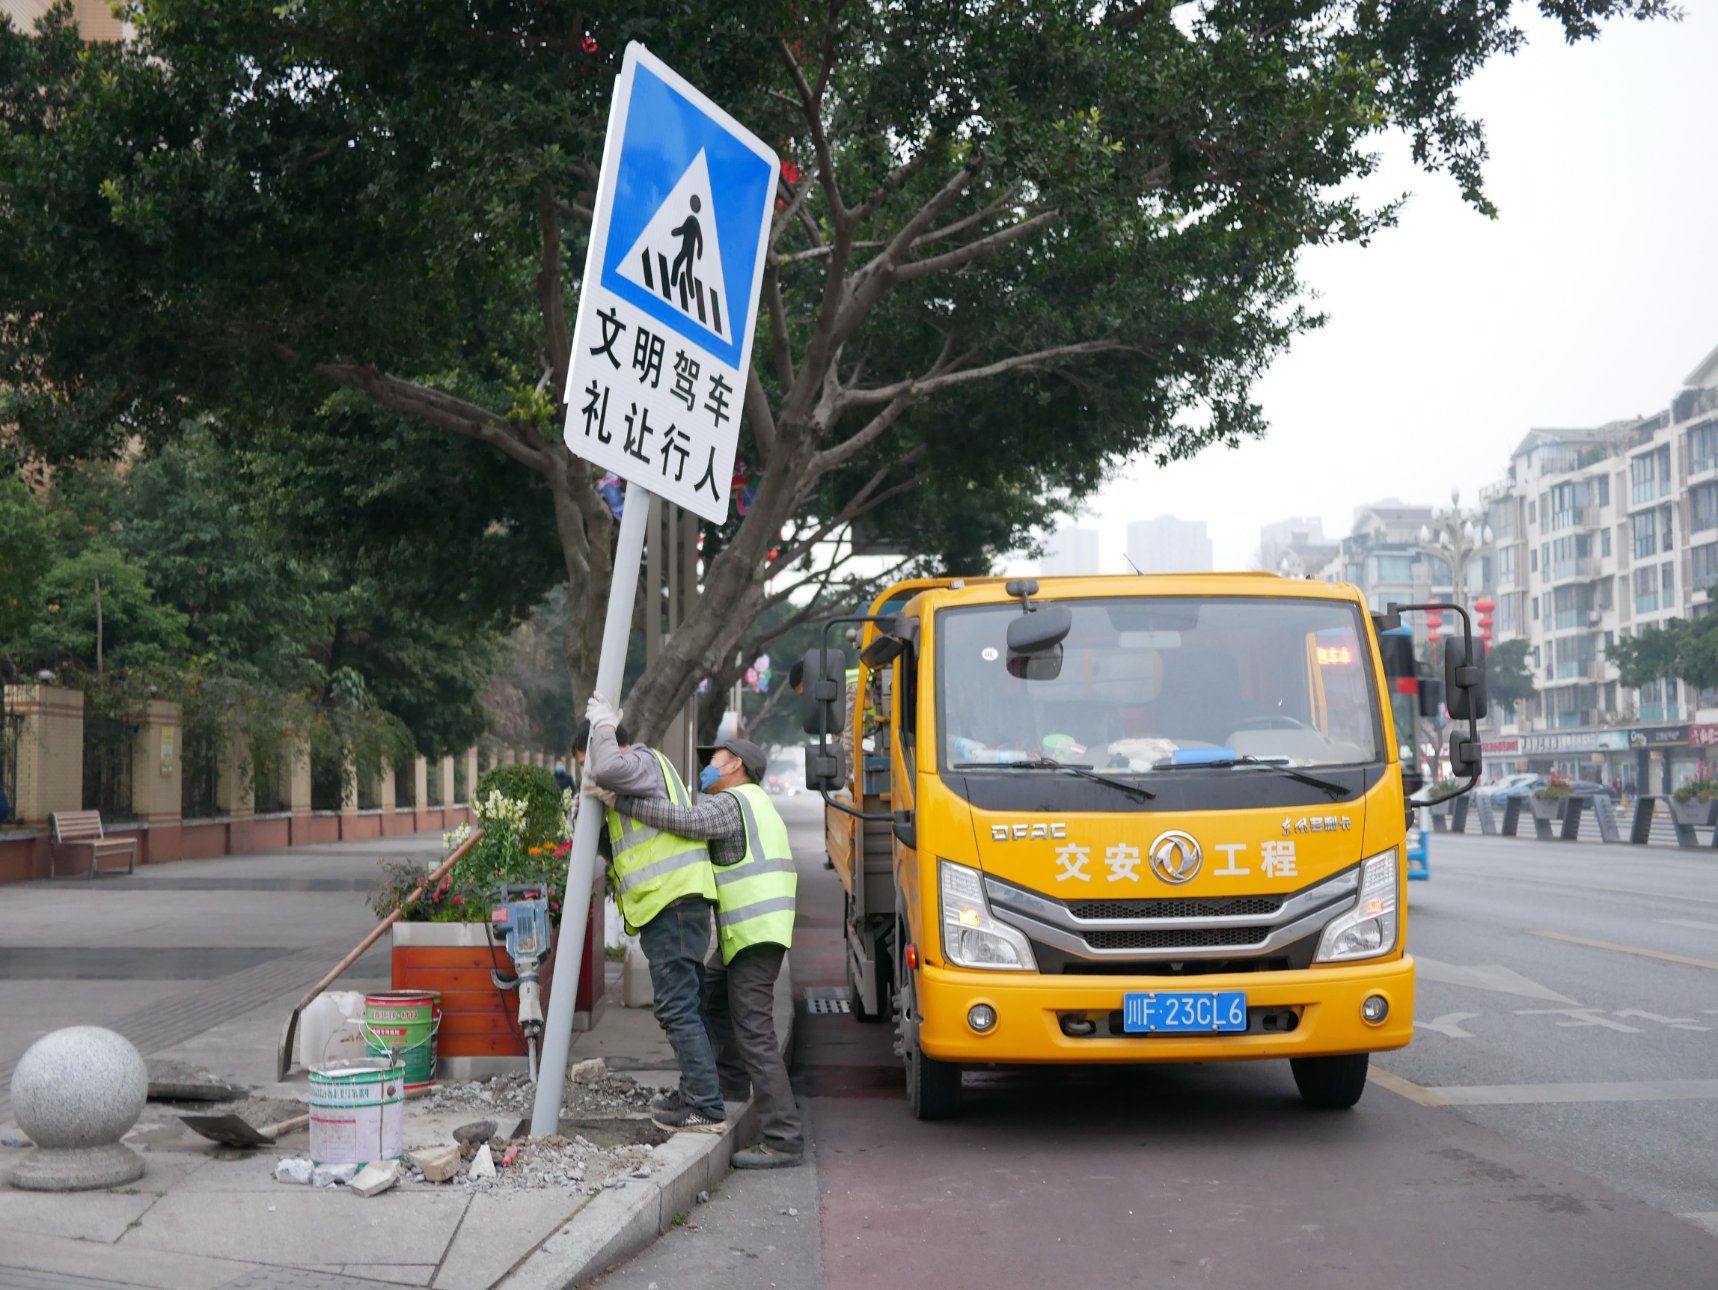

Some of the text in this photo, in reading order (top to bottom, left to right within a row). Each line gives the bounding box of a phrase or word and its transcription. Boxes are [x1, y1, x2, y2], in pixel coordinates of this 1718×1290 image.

[589, 308, 733, 427] 文明驾车
[582, 380, 720, 503] 礼让行人
[991, 823, 1066, 841] DFAC
[1054, 840, 1298, 882] 交安 工程
